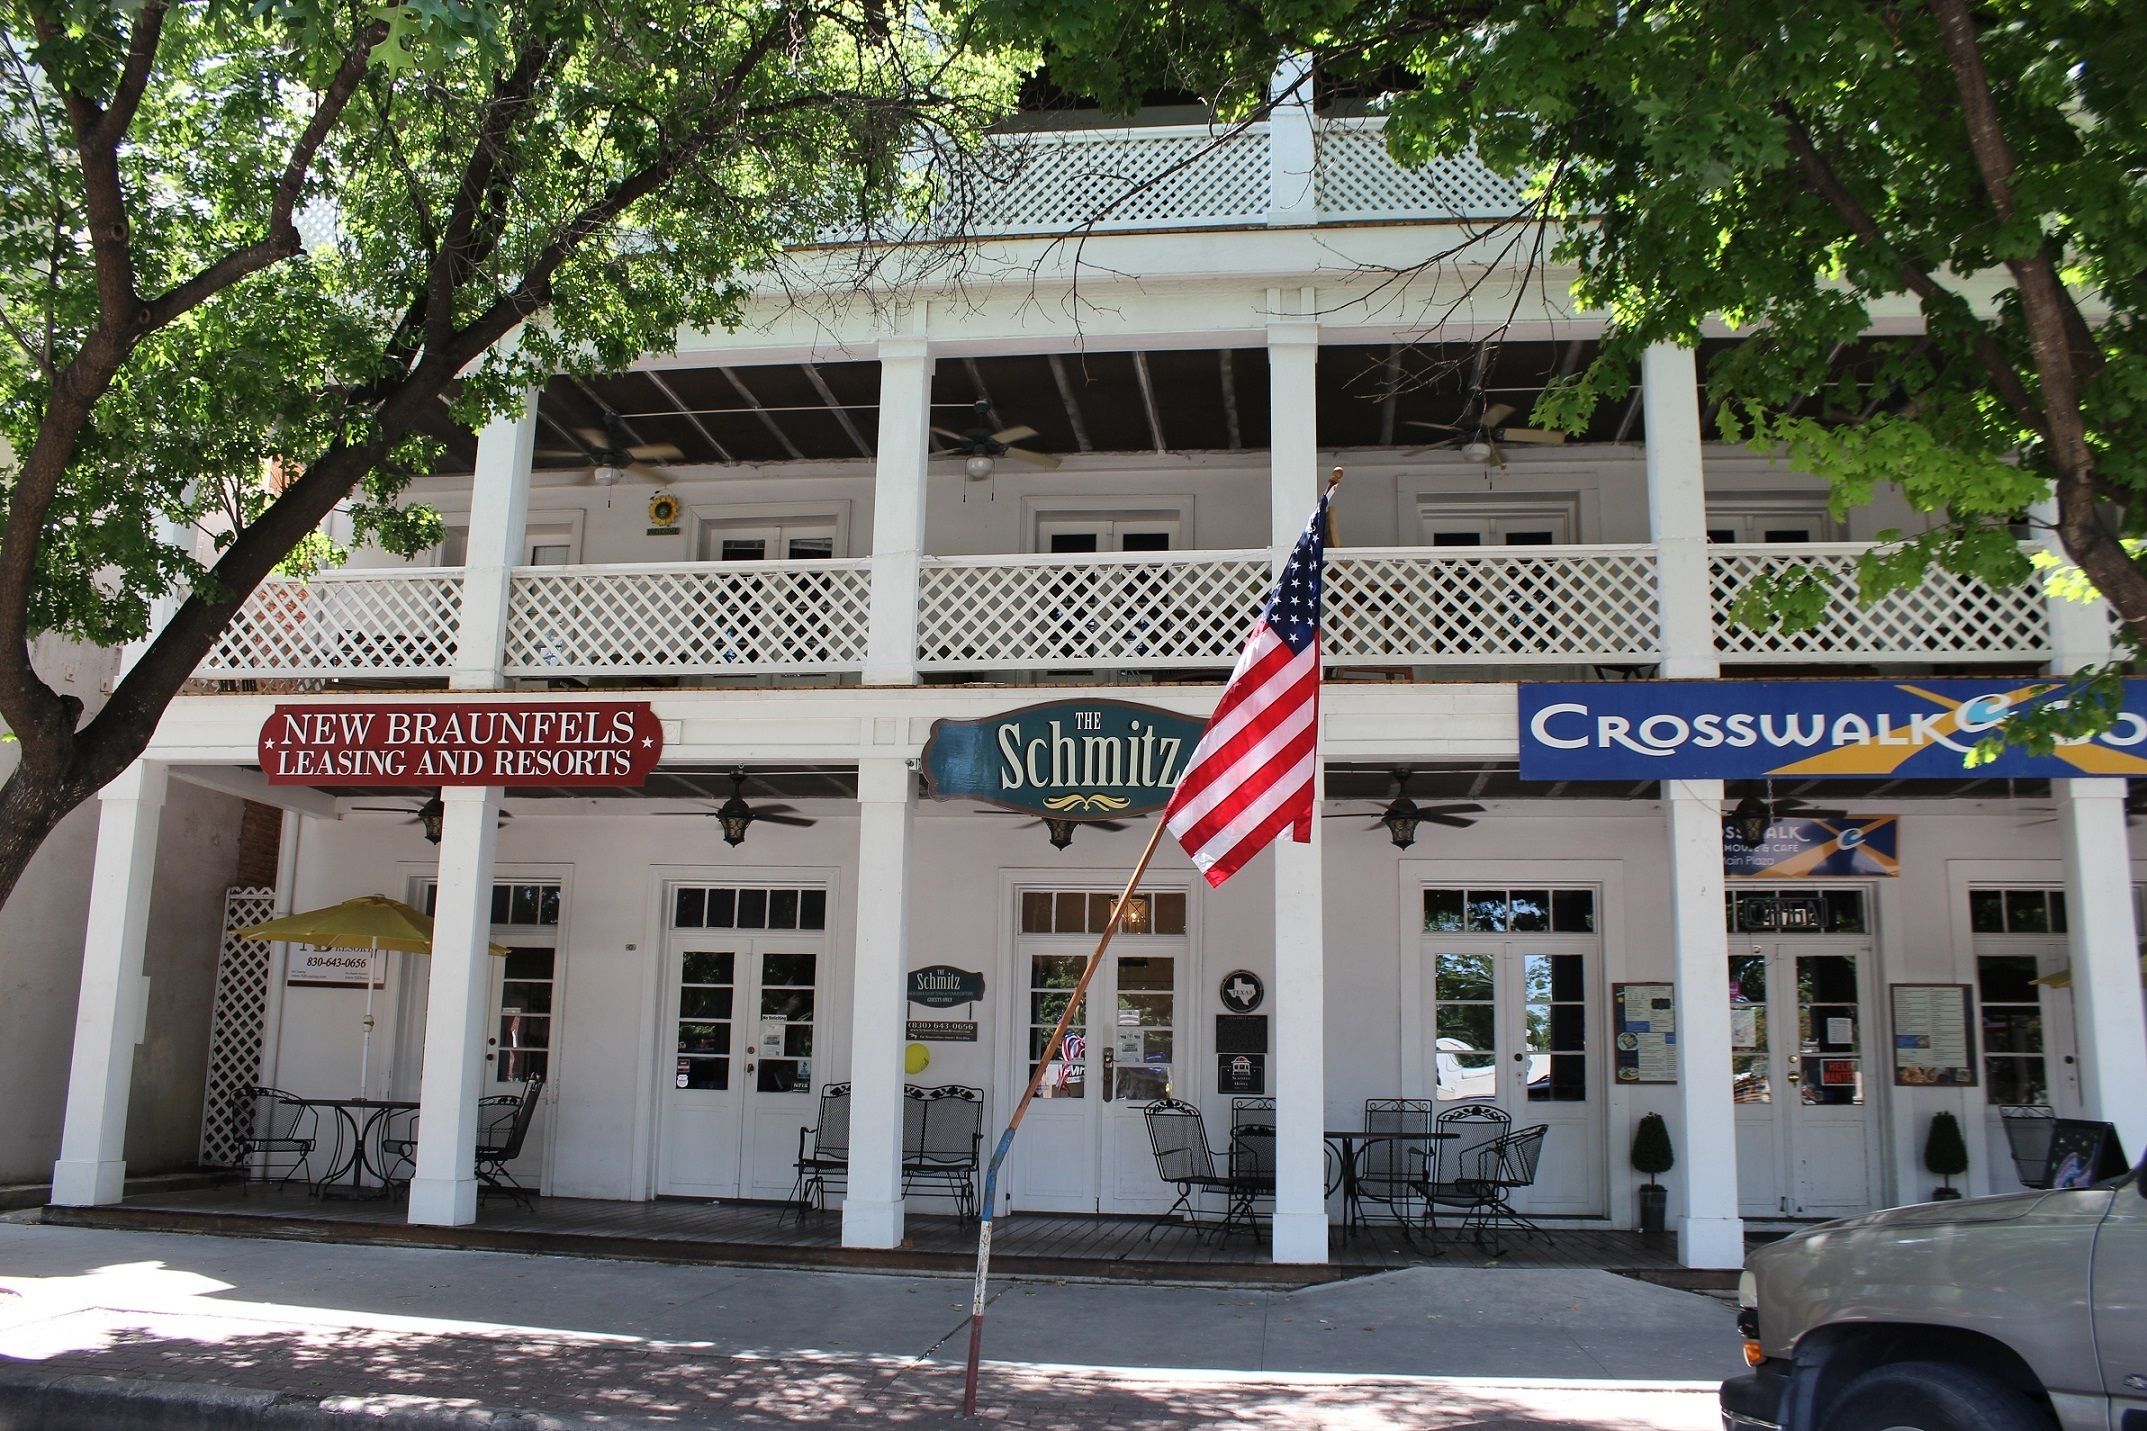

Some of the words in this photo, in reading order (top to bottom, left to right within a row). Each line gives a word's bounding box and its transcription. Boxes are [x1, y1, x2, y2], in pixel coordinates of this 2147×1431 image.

[280, 713, 374, 745] NEW
[384, 711, 635, 745] BRAUNFELS
[1075, 712, 1101, 730] THE
[1530, 703, 1977, 756] CROSSWALK
[276, 750, 408, 776] LEASING
[414, 750, 483, 776] AND
[492, 749, 632, 776] RESORTS
[998, 720, 1181, 790] Schmitz
[1724, 856, 1743, 866] ain
[1746, 856, 1774, 866] Plaza
[306, 957, 367, 968] 830-643-0656
[917, 972, 960, 990] Schmitz
[933, 1022, 974, 1030] 643-0656
